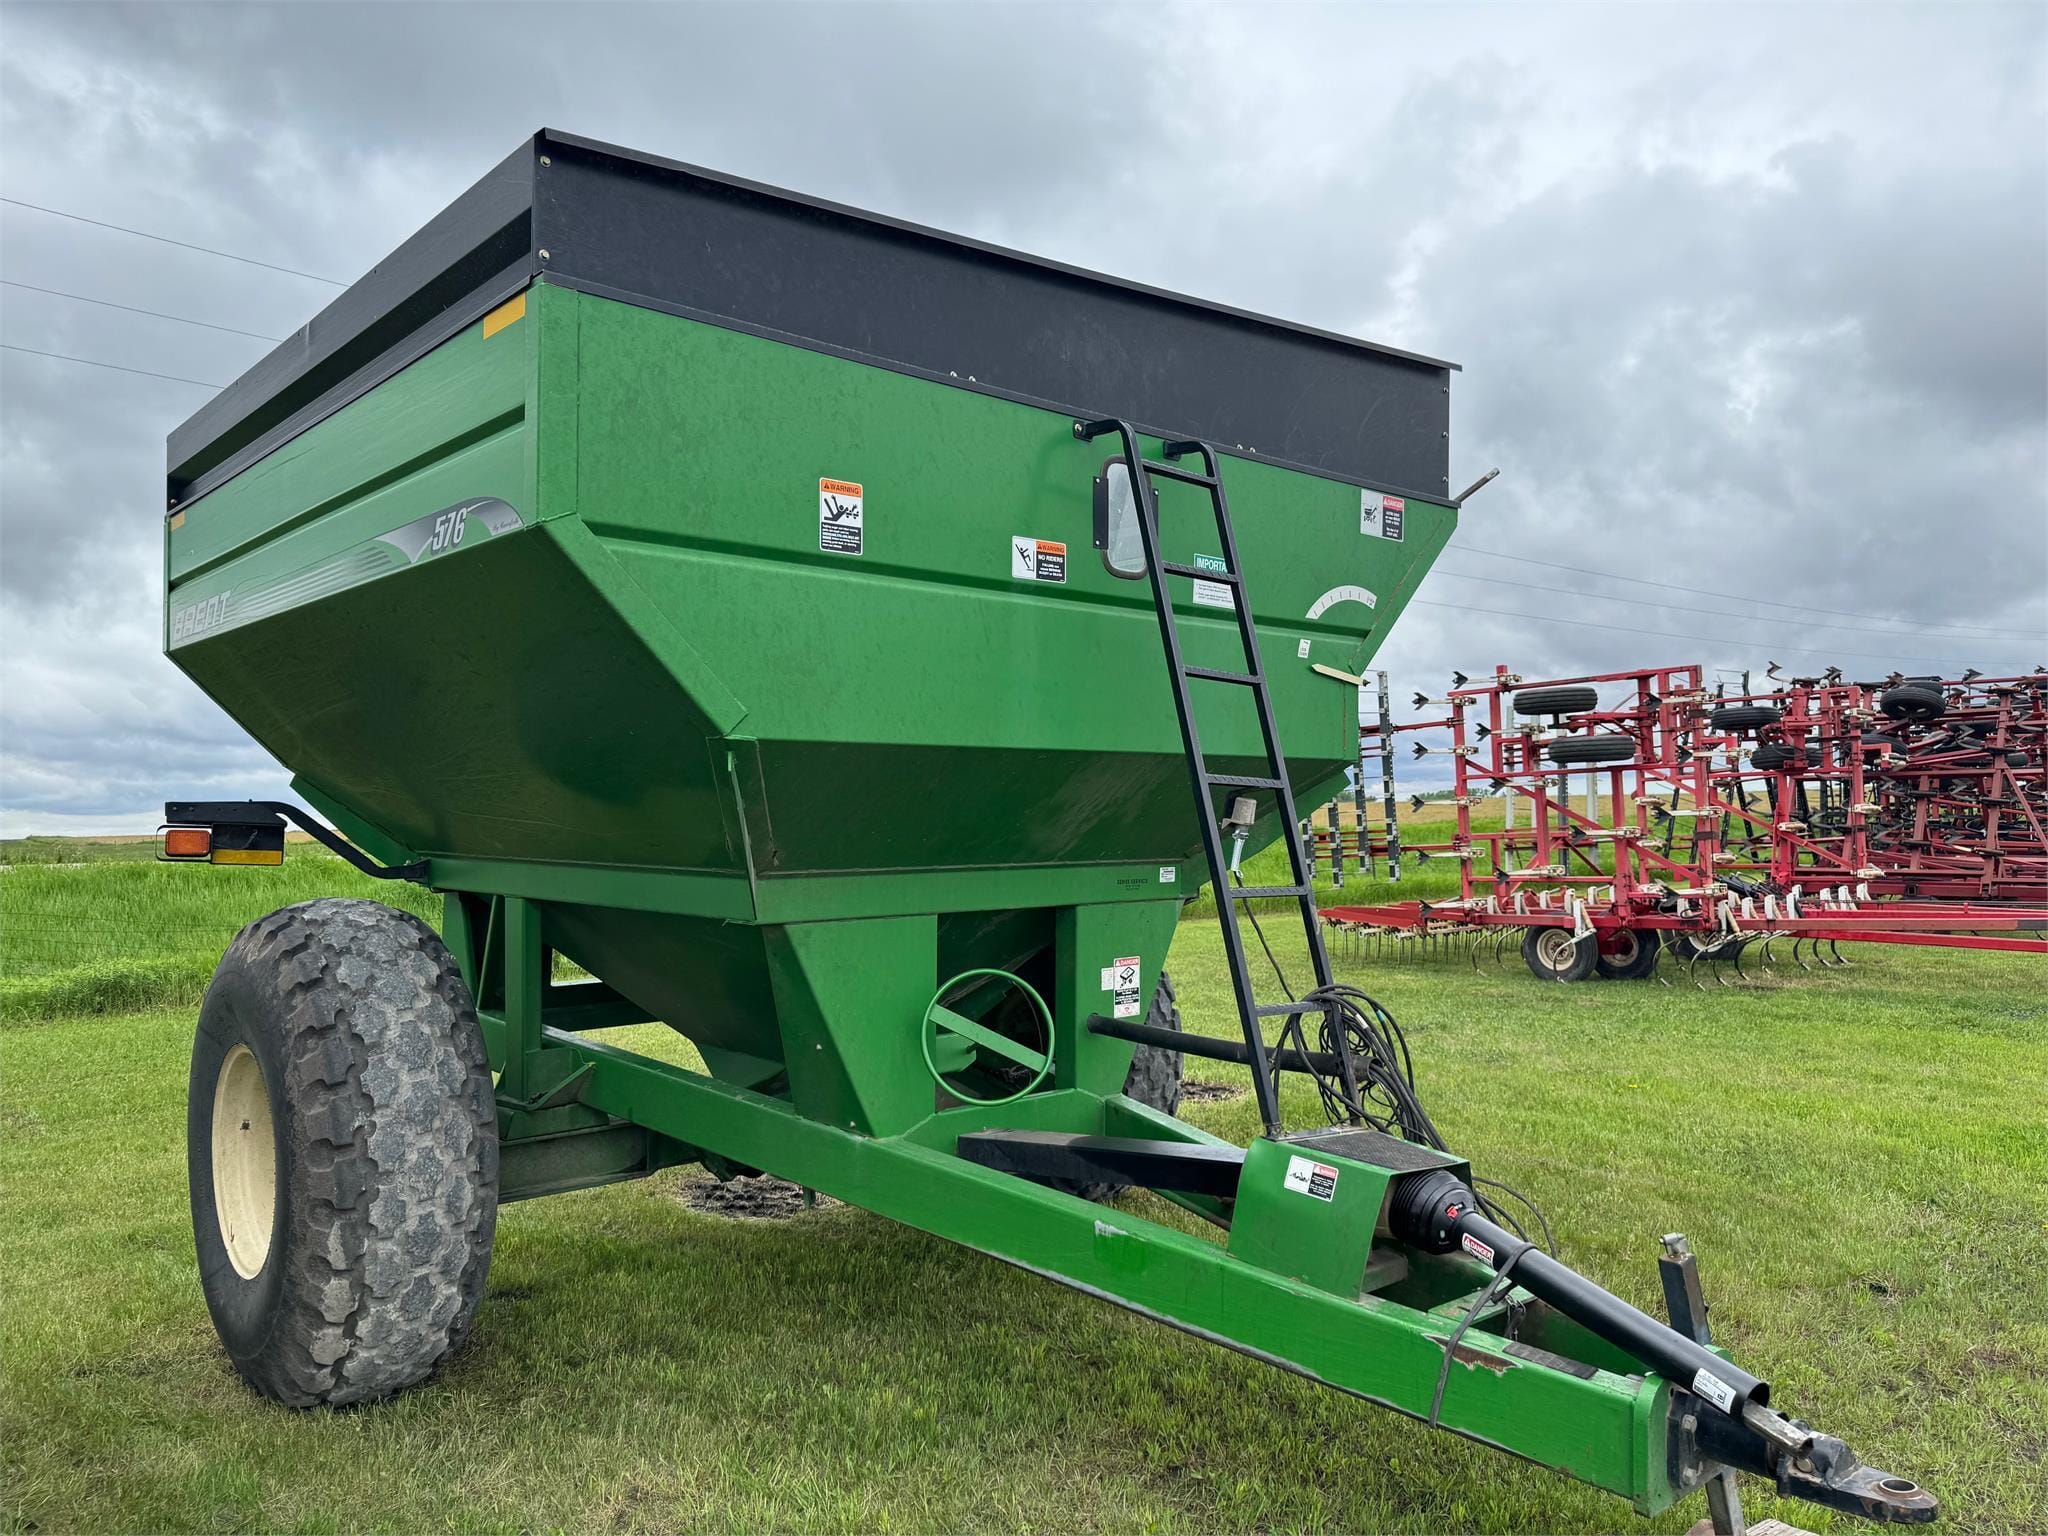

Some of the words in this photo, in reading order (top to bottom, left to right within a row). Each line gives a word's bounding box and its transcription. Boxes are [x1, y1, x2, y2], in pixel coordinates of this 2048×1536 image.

[830, 483, 859, 495] WARNING
[432, 507, 467, 551] 576
[1042, 544, 1064, 553] WARNING
[1046, 555, 1064, 563] RIDERS
[173, 590, 231, 641] BRENT
[1470, 1241, 1492, 1260] DANGER
